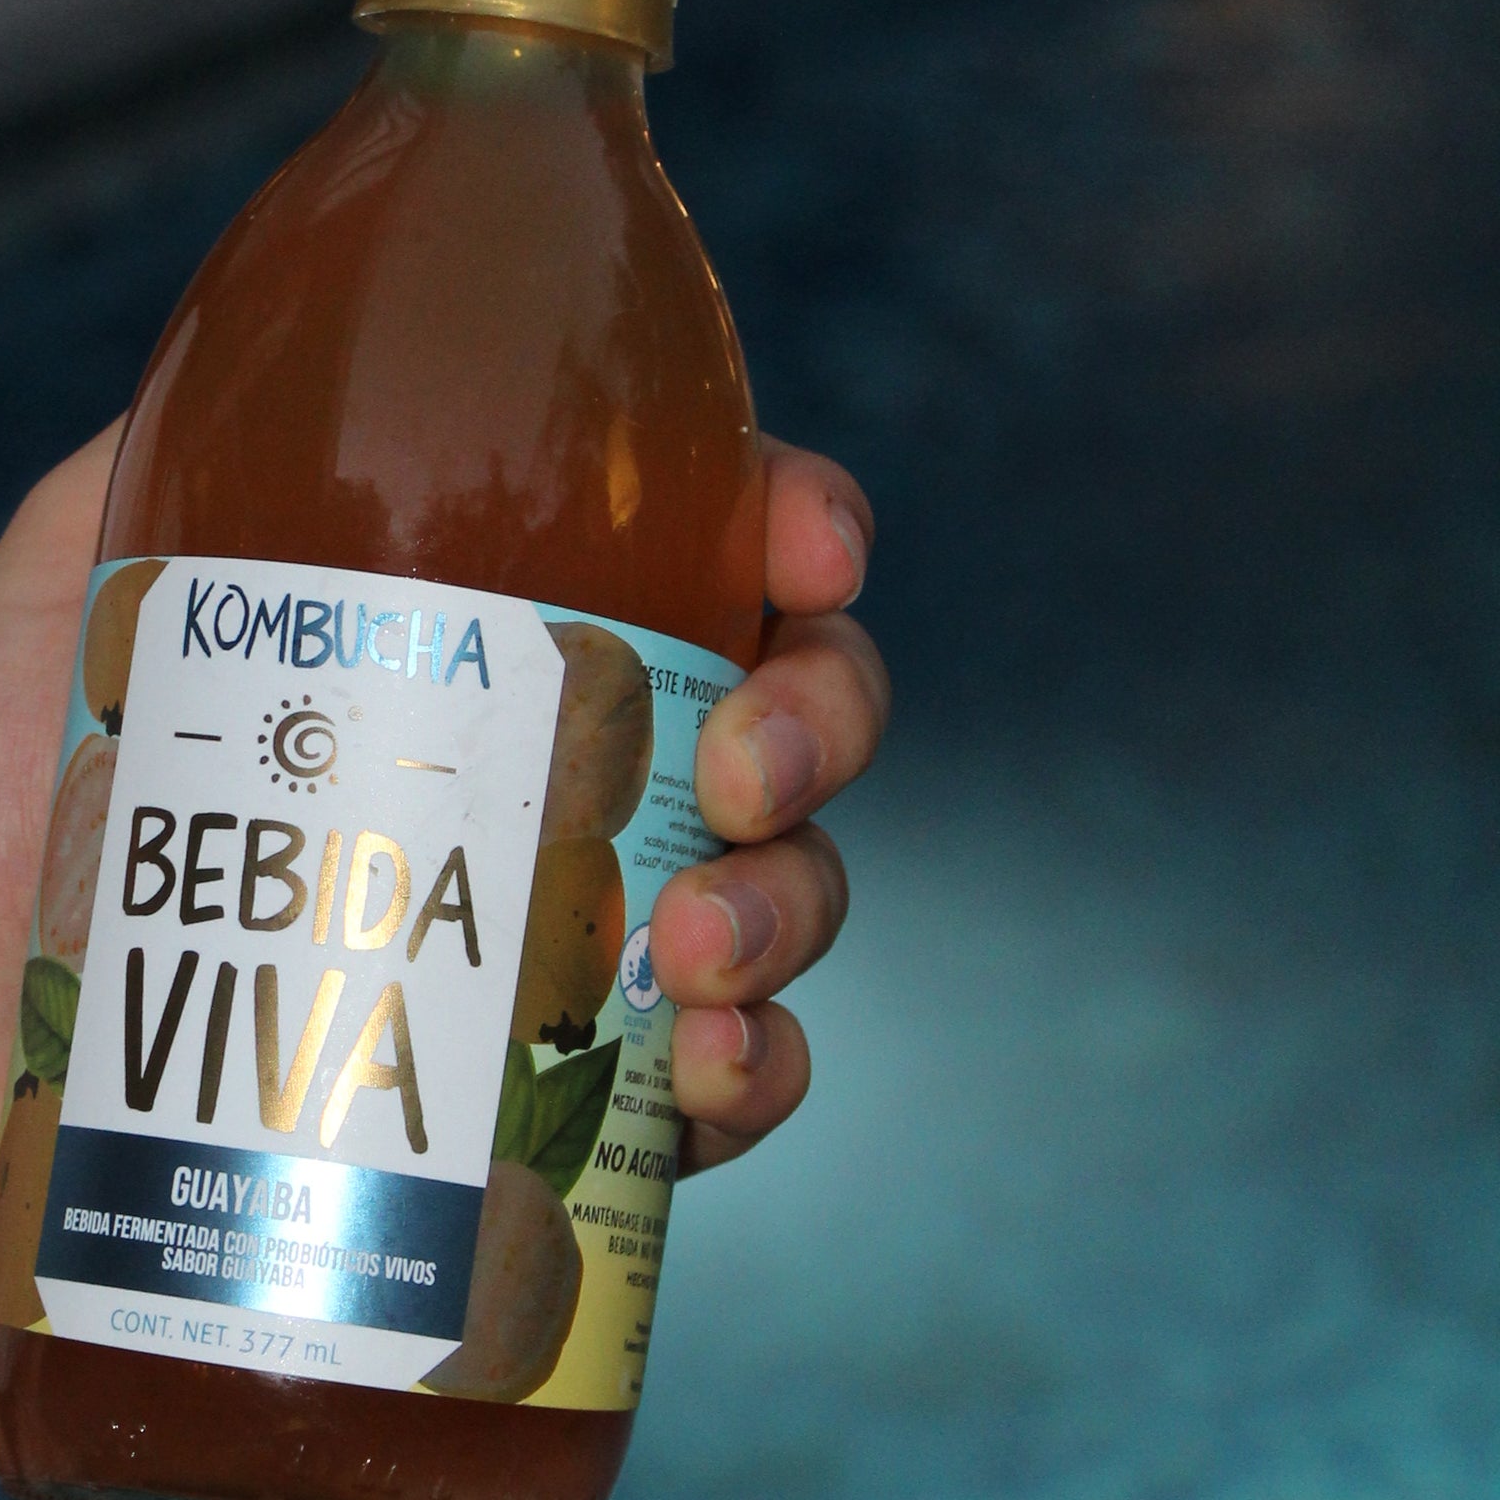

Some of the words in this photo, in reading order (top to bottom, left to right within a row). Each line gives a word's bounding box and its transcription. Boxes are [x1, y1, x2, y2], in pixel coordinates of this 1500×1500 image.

[183, 577, 490, 689] KOMBUCHA
[682, 675, 730, 705] PRODUCT
[122, 806, 481, 968] BEBIDA
[125, 947, 428, 1154] VIVA
[612, 1093, 643, 1115] MEZCLA
[595, 1141, 626, 1172] NO
[170, 1166, 312, 1224] GUAYABA
[571, 1202, 641, 1232] MANTÉNGASE
[63, 1207, 110, 1236] BEBIDA
[112, 1213, 220, 1252] FERMENTADA
[223, 1230, 259, 1258] CON
[264, 1236, 380, 1278] PROBIÓTICOS
[385, 1255, 438, 1286] VIVOS
[161, 1247, 218, 1278] SABOR
[220, 1256, 306, 1289] GUAYABA
[110, 1308, 174, 1340] CONT.
[181, 1319, 231, 1348] NET.
[239, 1328, 296, 1359] 377
[303, 1340, 342, 1366] mL
